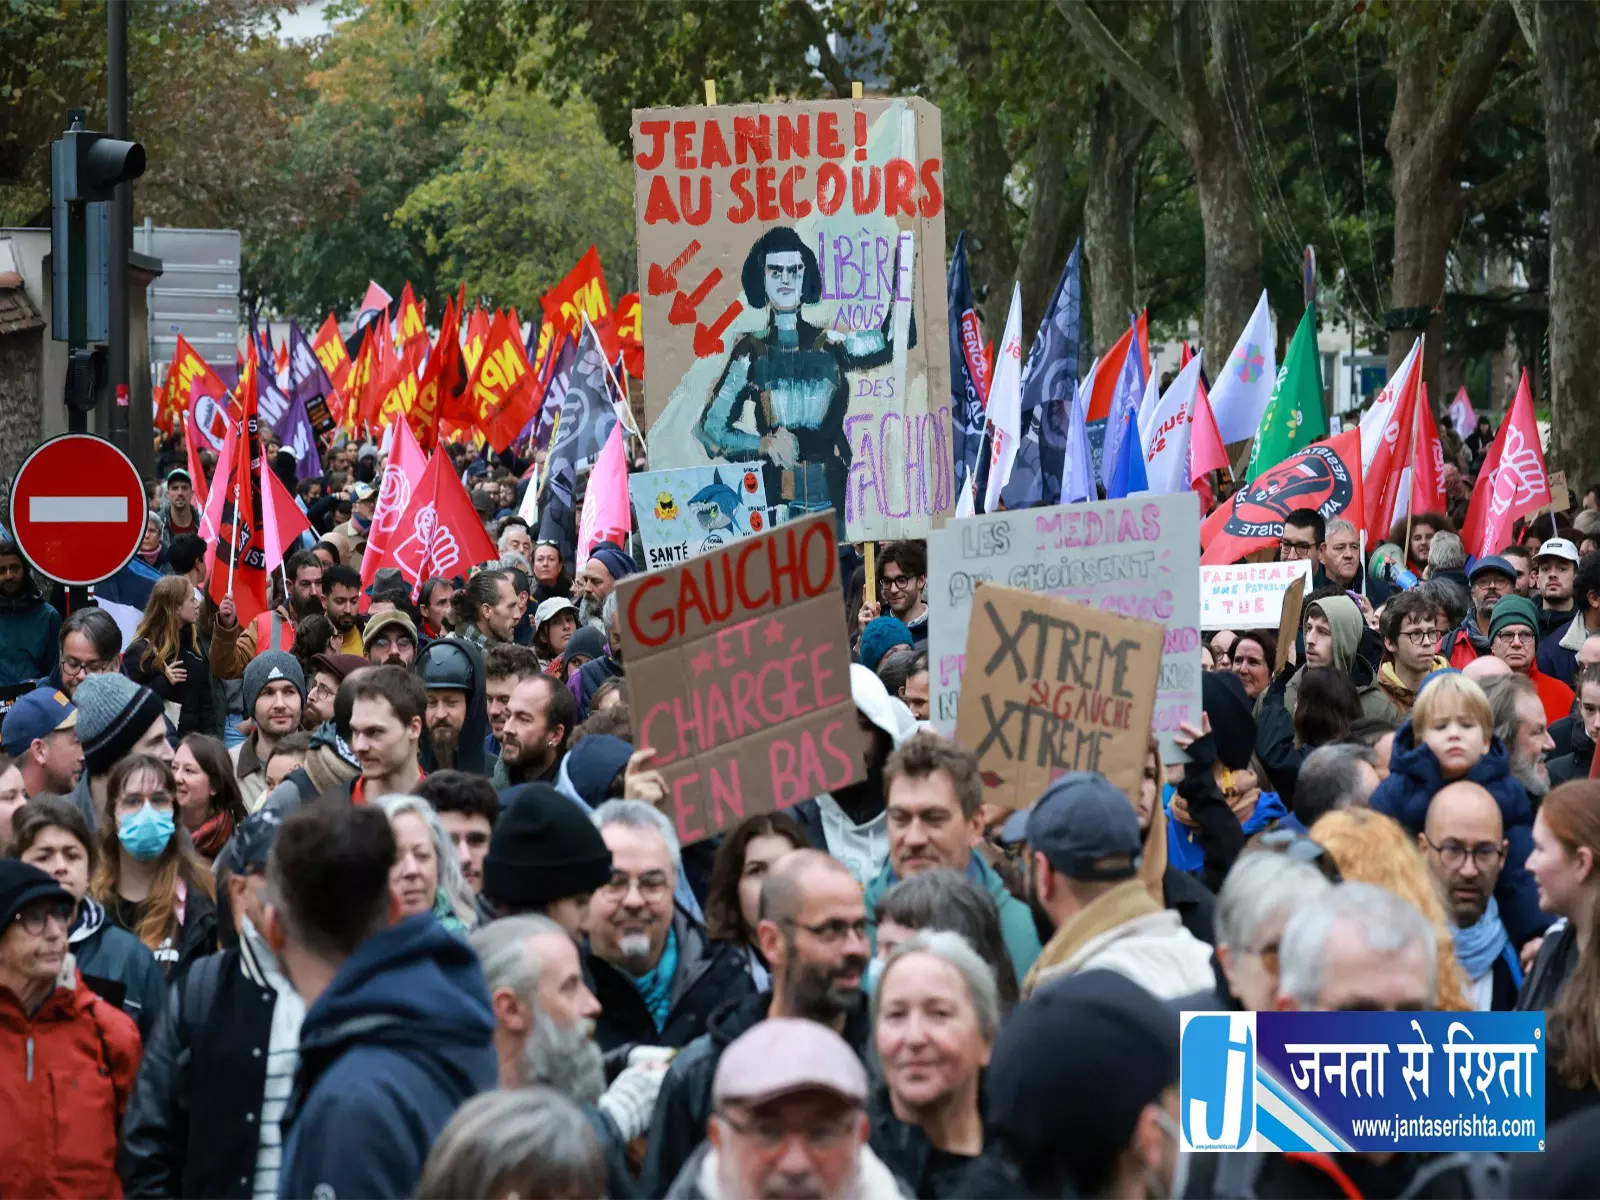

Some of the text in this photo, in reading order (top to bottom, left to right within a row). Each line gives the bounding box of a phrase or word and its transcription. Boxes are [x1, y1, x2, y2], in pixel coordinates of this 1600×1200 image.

[644, 158, 944, 226] AU SECOURS
[833, 303, 884, 331] NOUS
[857, 376, 895, 398] DES
[844, 406, 951, 525] FACHOS
[649, 540, 688, 563] SANTÉ
[962, 503, 1161, 559] LES MEDIAS
[627, 521, 835, 647] GAUCHO
[1222, 597, 1265, 614] TUE
[716, 618, 760, 667] ET
[984, 600, 1141, 698] XTREME
[639, 638, 846, 767] CHARGÉE
[1053, 684, 1133, 731] GAUCHE
[673, 721, 854, 842] EN BAS
